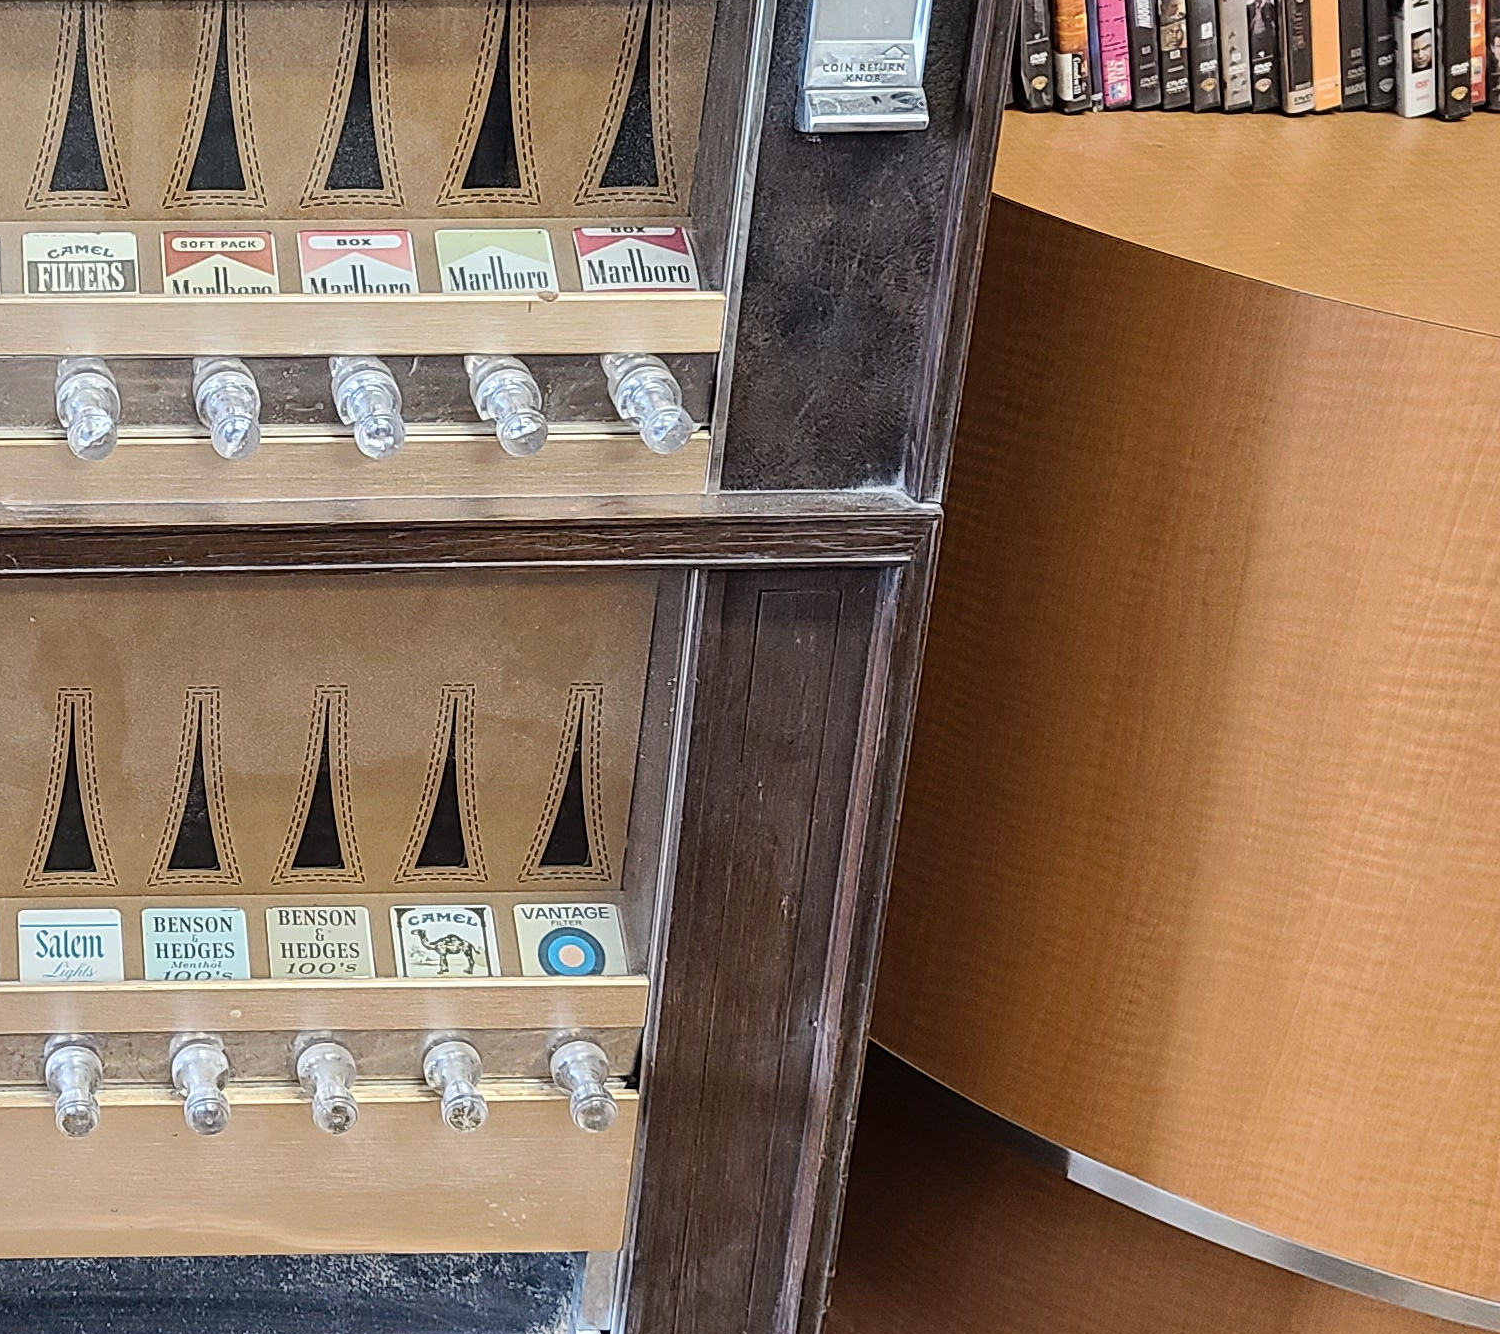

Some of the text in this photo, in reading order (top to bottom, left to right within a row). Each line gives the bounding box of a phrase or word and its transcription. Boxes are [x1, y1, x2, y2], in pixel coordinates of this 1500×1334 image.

[822, 62, 906, 73] COIN RETURN
[846, 74, 881, 82] KNOB
[179, 240, 257, 249] SOFT PACK
[336, 238, 372, 246] BOX
[47, 244, 114, 259] CAMEL
[587, 248, 691, 285] Marlboro
[37, 261, 125, 292] FILTERS
[447, 255, 549, 293] Marlboro
[277, 909, 357, 927] BENSON
[408, 912, 478, 927] CAMEL
[520, 906, 610, 920] VANTAGE
[153, 916, 234, 933] BENSON
[550, 919, 583, 927] FILTER
[191, 934, 199, 943] &
[315, 927, 325, 941] &
[35, 929, 105, 960] Salem
[155, 942, 236, 959] HEDGES
[280, 942, 360, 960] HEDGES
[42, 961, 96, 981] Lights
[170, 960, 223, 969] Menthol
[285, 961, 357, 974] 100's
[163, 970, 234, 981] 100's
